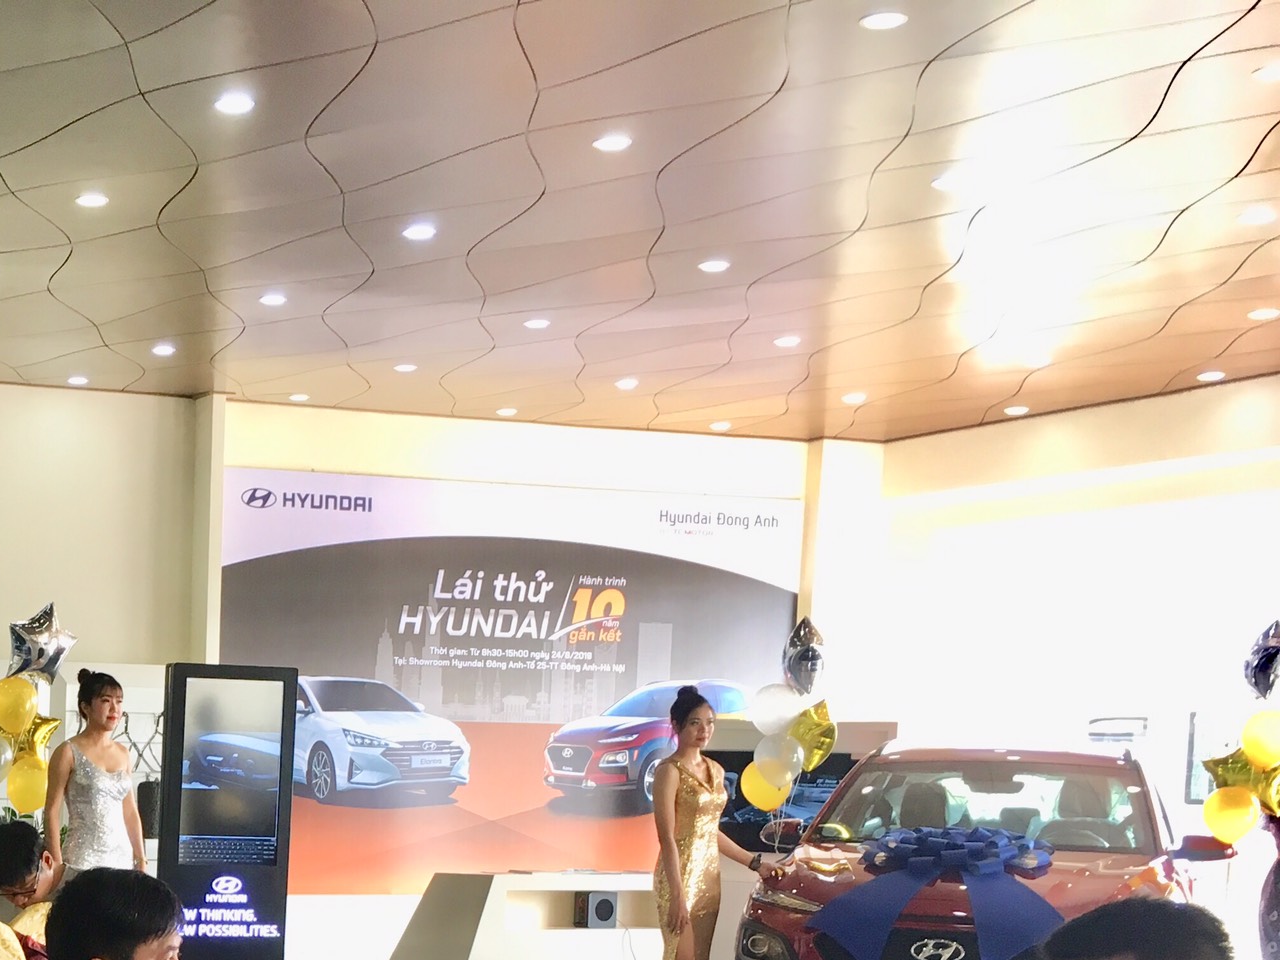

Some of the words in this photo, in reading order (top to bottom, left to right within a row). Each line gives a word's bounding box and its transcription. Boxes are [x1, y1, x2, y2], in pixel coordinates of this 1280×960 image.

[282, 492, 373, 512] HYUNDAI
[659, 510, 712, 526] Hyundai
[754, 515, 779, 527] Anh
[433, 569, 485, 600] Lái
[493, 569, 554, 603] thử
[579, 575, 603, 586] Hành
[605, 576, 627, 587] trình
[571, 588, 626, 625] 10
[398, 605, 551, 640] HYUNDAI
[602, 619, 620, 628] năm
[569, 625, 595, 644] gắn
[599, 627, 623, 642] kết
[429, 646, 448, 655] Thời
[449, 648, 468, 657] gian:
[470, 647, 481, 656] Từ
[530, 650, 550, 660] ngày
[409, 657, 450, 666] Showroom
[451, 659, 484, 668] Hyundai
[486, 659, 507, 670] Đông
[560, 662, 581, 672] Đông
[612, 664, 626, 673] Nội
[205, 894, 248, 903] HYUNDAI
[199, 908, 258, 922] THINKING.
[198, 924, 280, 937] POSSIBILITIES.
